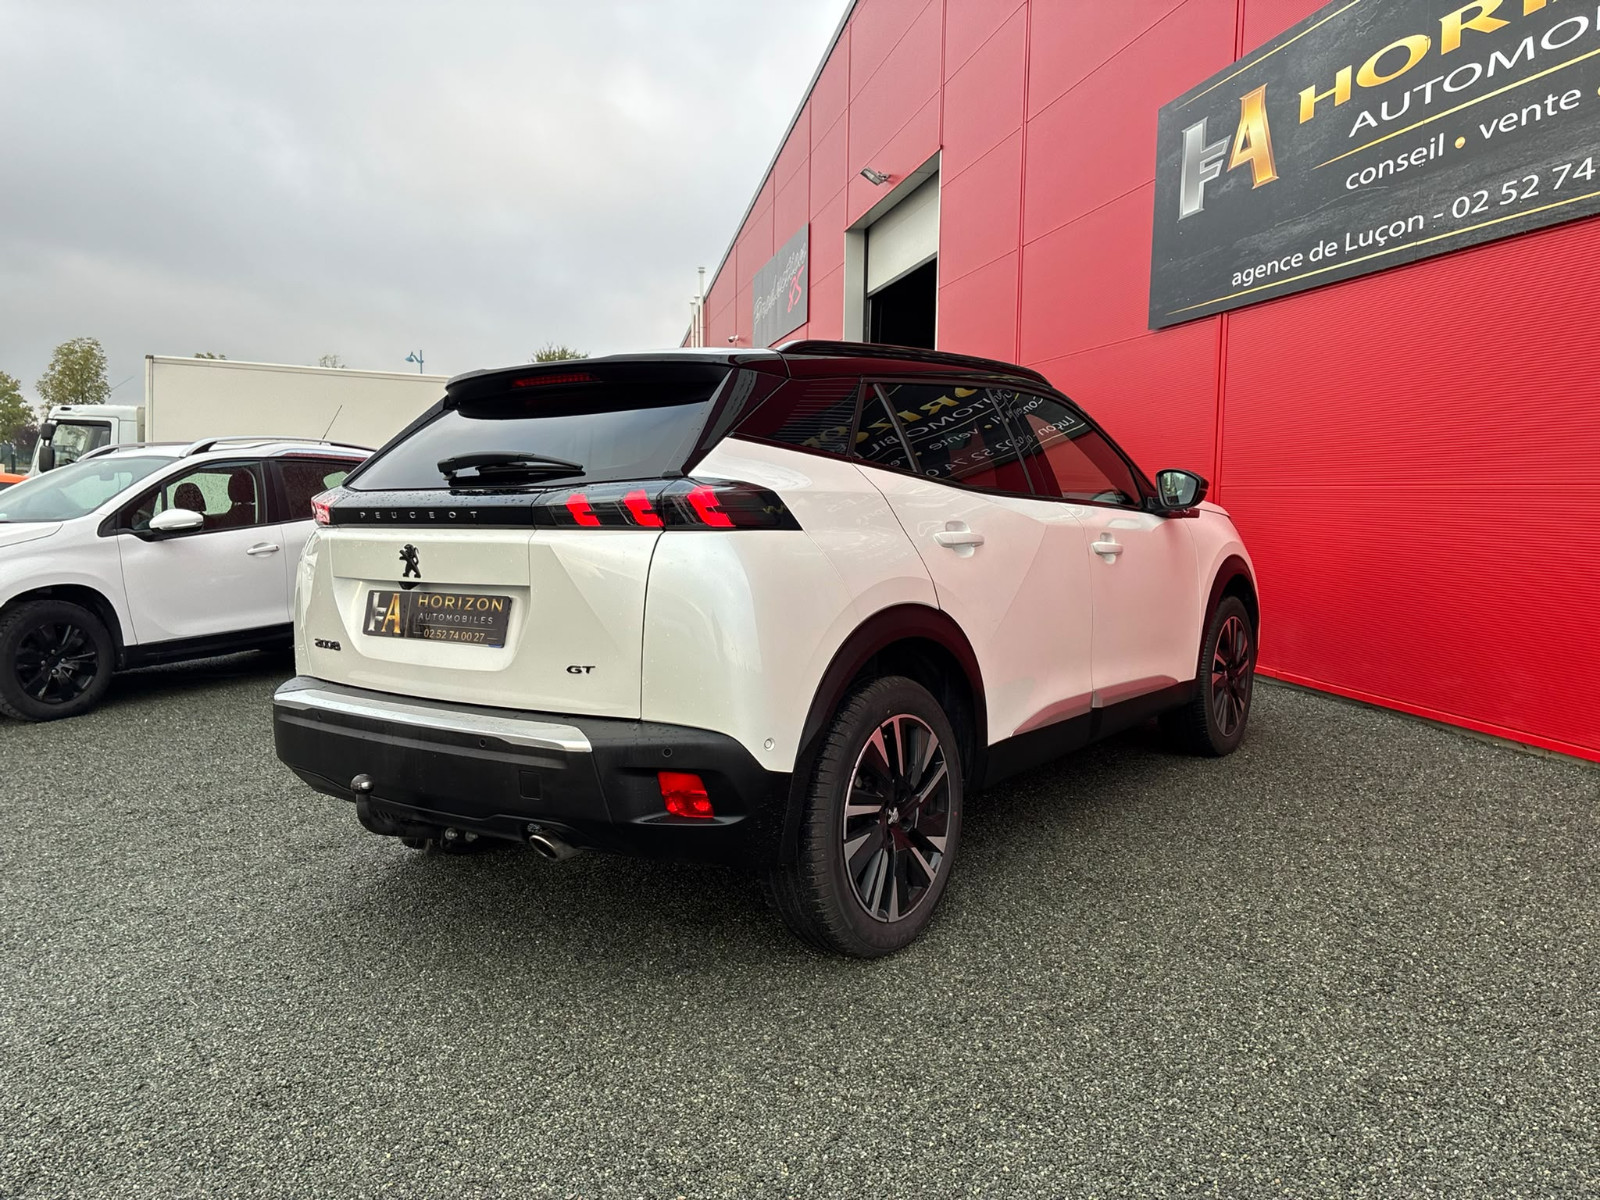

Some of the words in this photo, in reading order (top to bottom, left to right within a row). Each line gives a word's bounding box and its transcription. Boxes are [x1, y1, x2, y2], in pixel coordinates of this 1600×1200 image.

[1349, 5, 1600, 138] AUTOMO
[1346, 132, 1445, 190] conseil
[1479, 89, 1582, 139] vente
[1231, 252, 1304, 287] agence
[1309, 241, 1338, 262] de
[1344, 214, 1425, 252] Luçon
[1451, 190, 1489, 219] 02
[1500, 175, 1540, 205] 52
[1552, 157, 1596, 190] 74
[360, 511, 478, 519] PEUGEOT
[418, 594, 504, 612] HORIZON
[418, 612, 494, 625] AUTOMOBILES
[424, 628, 434, 638] 02
[436, 629, 447, 639] 52
[449, 630, 459, 640] 74
[461, 631, 472, 641] 00
[474, 632, 485, 642] 27
[314, 638, 341, 651] 2008
[566, 665, 596, 674] GT
